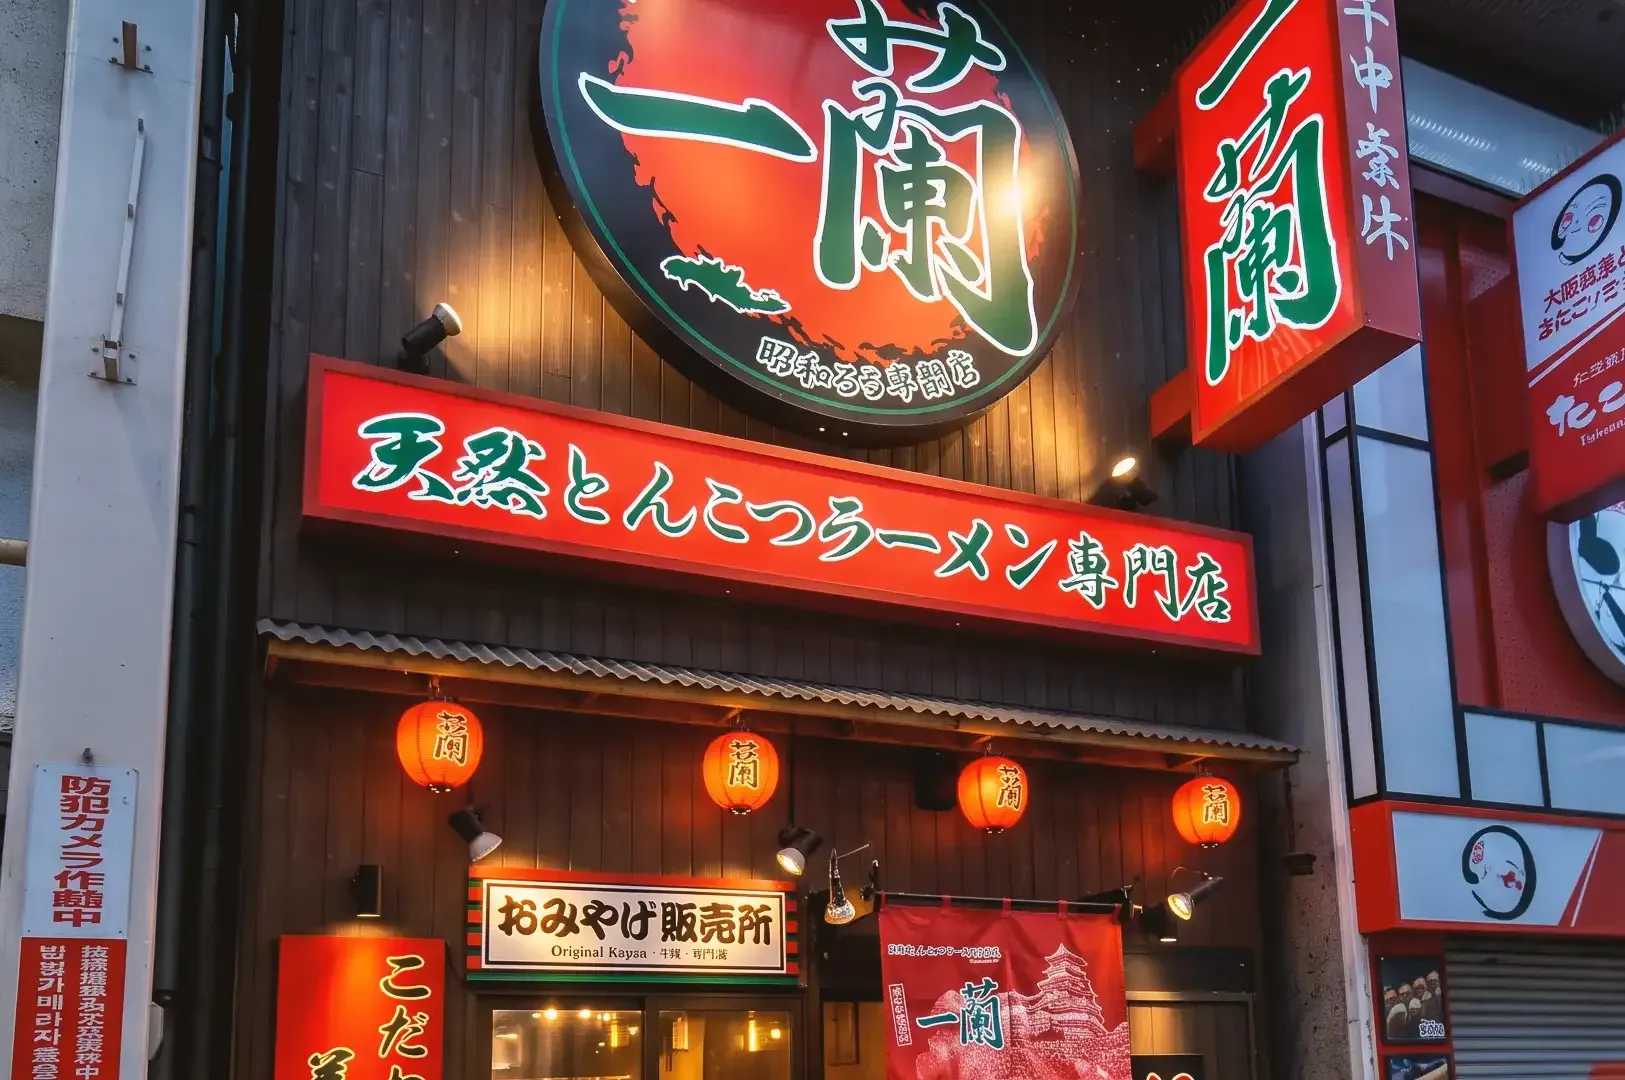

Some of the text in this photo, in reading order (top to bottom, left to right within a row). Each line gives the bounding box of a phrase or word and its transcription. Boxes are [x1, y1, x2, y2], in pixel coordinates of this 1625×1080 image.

[578, 0, 1038, 356] 一蘭
[352, 412, 1231, 624] 天然とんこつラーメン専門店
[728, 739, 761, 790] 蘭
[997, 765, 1024, 812] 蘭
[1202, 783, 1231, 826] 蘭
[497, 894, 773, 946] おみやげ販売所
[551, 945, 604, 960] Original
[608, 946, 648, 961] Kaysa
[916, 976, 1005, 1050] 一蘭
